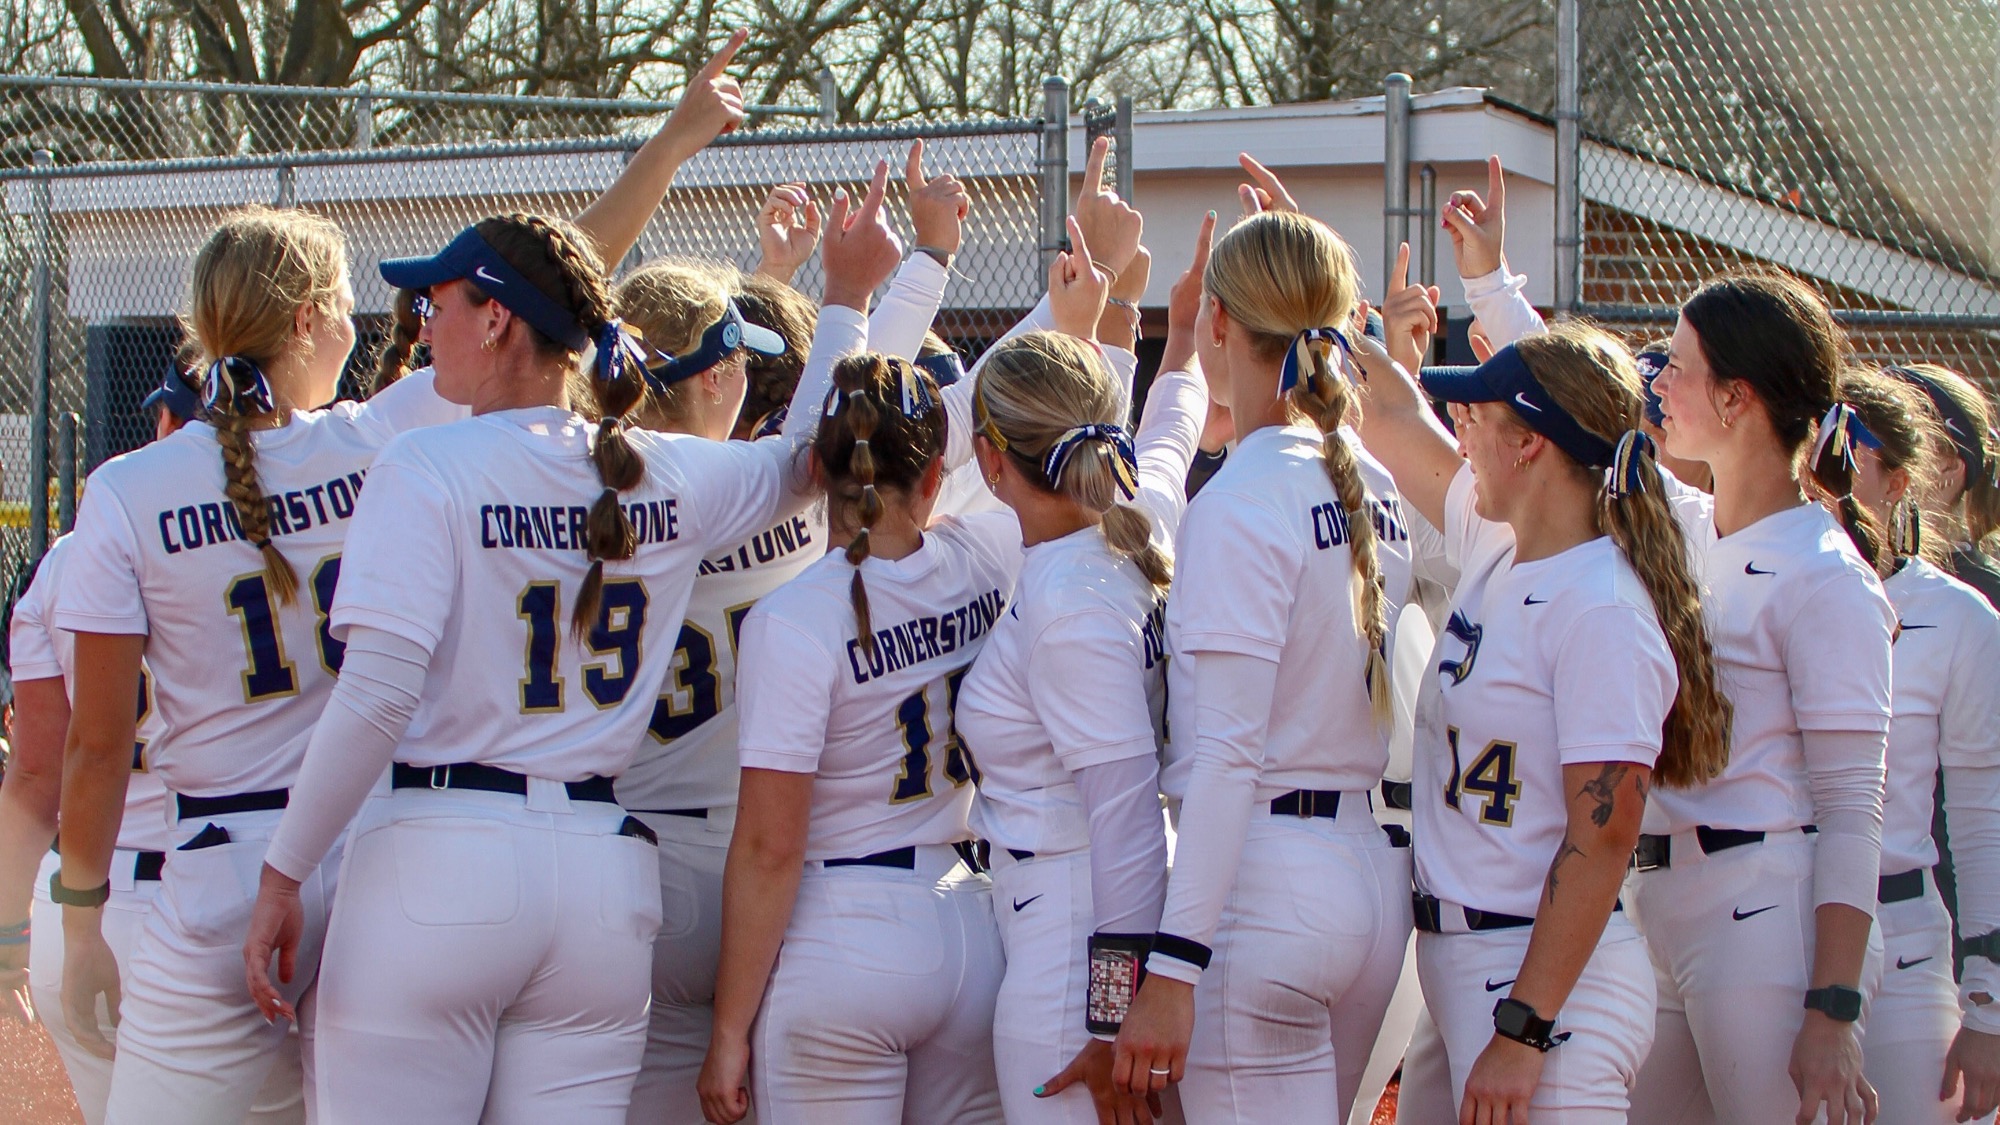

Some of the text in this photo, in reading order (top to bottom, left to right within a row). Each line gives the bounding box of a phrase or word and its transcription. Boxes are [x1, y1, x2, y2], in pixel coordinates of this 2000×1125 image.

[158, 469, 368, 554] CORNRSTO
[481, 499, 679, 549] CORNERONE
[516, 576, 650, 713] 19
[1444, 724, 1522, 828] 14
